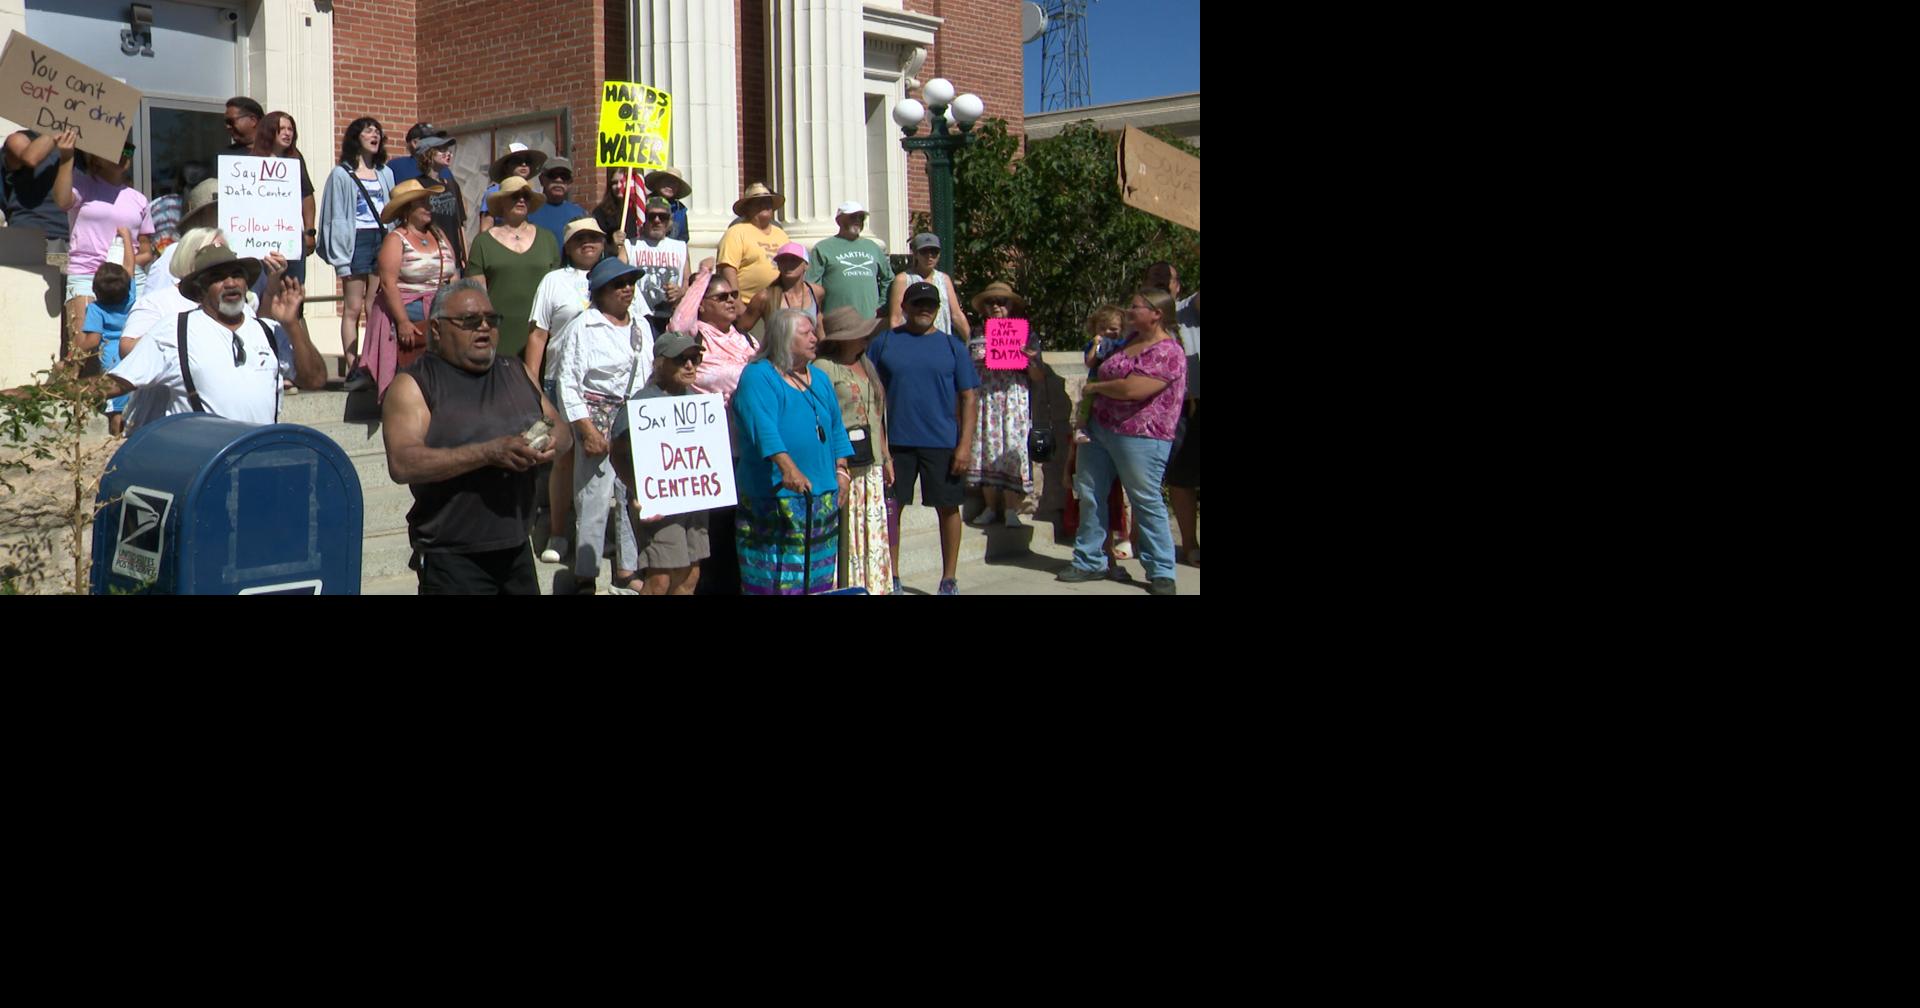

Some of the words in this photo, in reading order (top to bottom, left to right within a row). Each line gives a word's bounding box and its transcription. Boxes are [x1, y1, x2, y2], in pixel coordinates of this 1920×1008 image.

[31, 50, 58, 82] You
[21, 81, 59, 103] eat
[64, 98, 86, 112] or
[89, 105, 125, 131] drink
[605, 84, 668, 107] HANDS
[625, 122, 645, 133] MY
[599, 132, 662, 165] WATER
[231, 161, 256, 185] Say
[259, 160, 287, 181] NO
[224, 184, 252, 196] Data
[258, 185, 291, 197] Center
[230, 216, 270, 233] Follow
[275, 218, 296, 232] the
[245, 237, 281, 252] Money
[636, 250, 653, 265] VAN
[998, 321, 1013, 329] WE
[991, 338, 1021, 347] DRINK
[673, 402, 697, 427] NO
[660, 442, 711, 471] DATA
[644, 472, 722, 500] CENTERS
